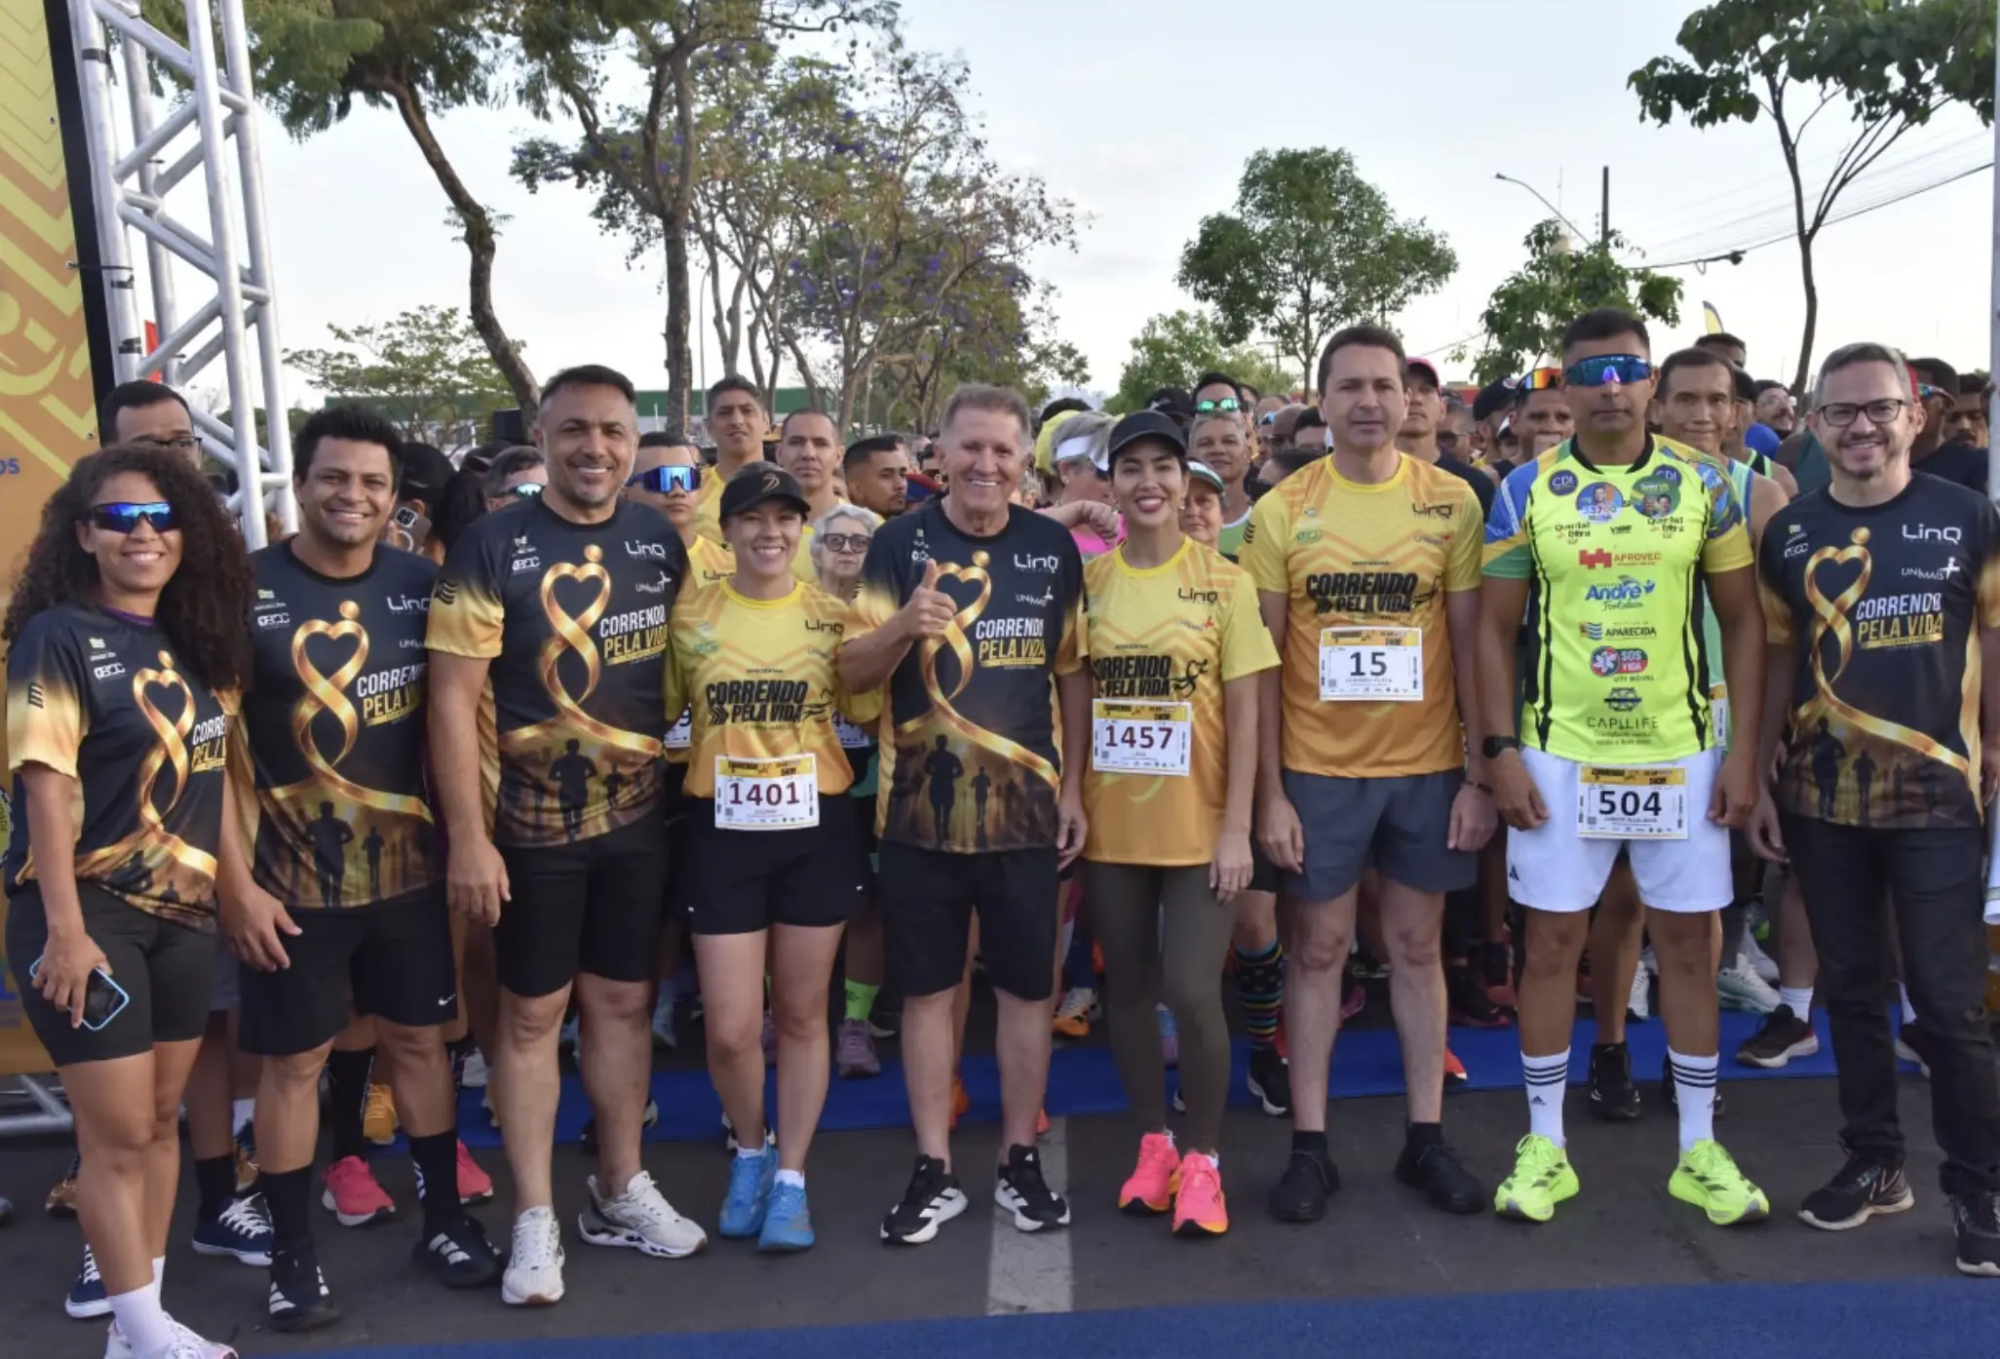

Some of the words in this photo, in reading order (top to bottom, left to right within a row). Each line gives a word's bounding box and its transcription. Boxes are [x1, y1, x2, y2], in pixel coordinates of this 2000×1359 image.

[1902, 524, 1962, 544] LinQ
[624, 540, 666, 559] LinQ
[1014, 553, 1059, 573] LinQ
[1306, 572, 1419, 598] CORRENDO
[1336, 595, 1374, 613] PELA
[1376, 594, 1412, 612] VIDA
[1856, 593, 1942, 620] CORRENDO
[600, 604, 665, 638] CORRENDO
[1605, 626, 1657, 637] APARECIDA
[1858, 617, 1900, 642] PELA
[1908, 612, 1944, 639] VIDA
[604, 631, 641, 659] PELA
[979, 637, 1016, 660] PELA
[1621, 650, 1642, 660] SOS
[1350, 651, 1388, 677] 15
[357, 661, 427, 697] CORREN
[1138, 678, 1169, 697] VIDA
[363, 689, 401, 719] PELA
[705, 680, 809, 707] CORRENDO
[731, 704, 767, 723] PELA
[769, 703, 803, 723] VIDA
[1105, 724, 1173, 749] 1457
[729, 781, 800, 806] 1401
[1599, 790, 1662, 816] 504
